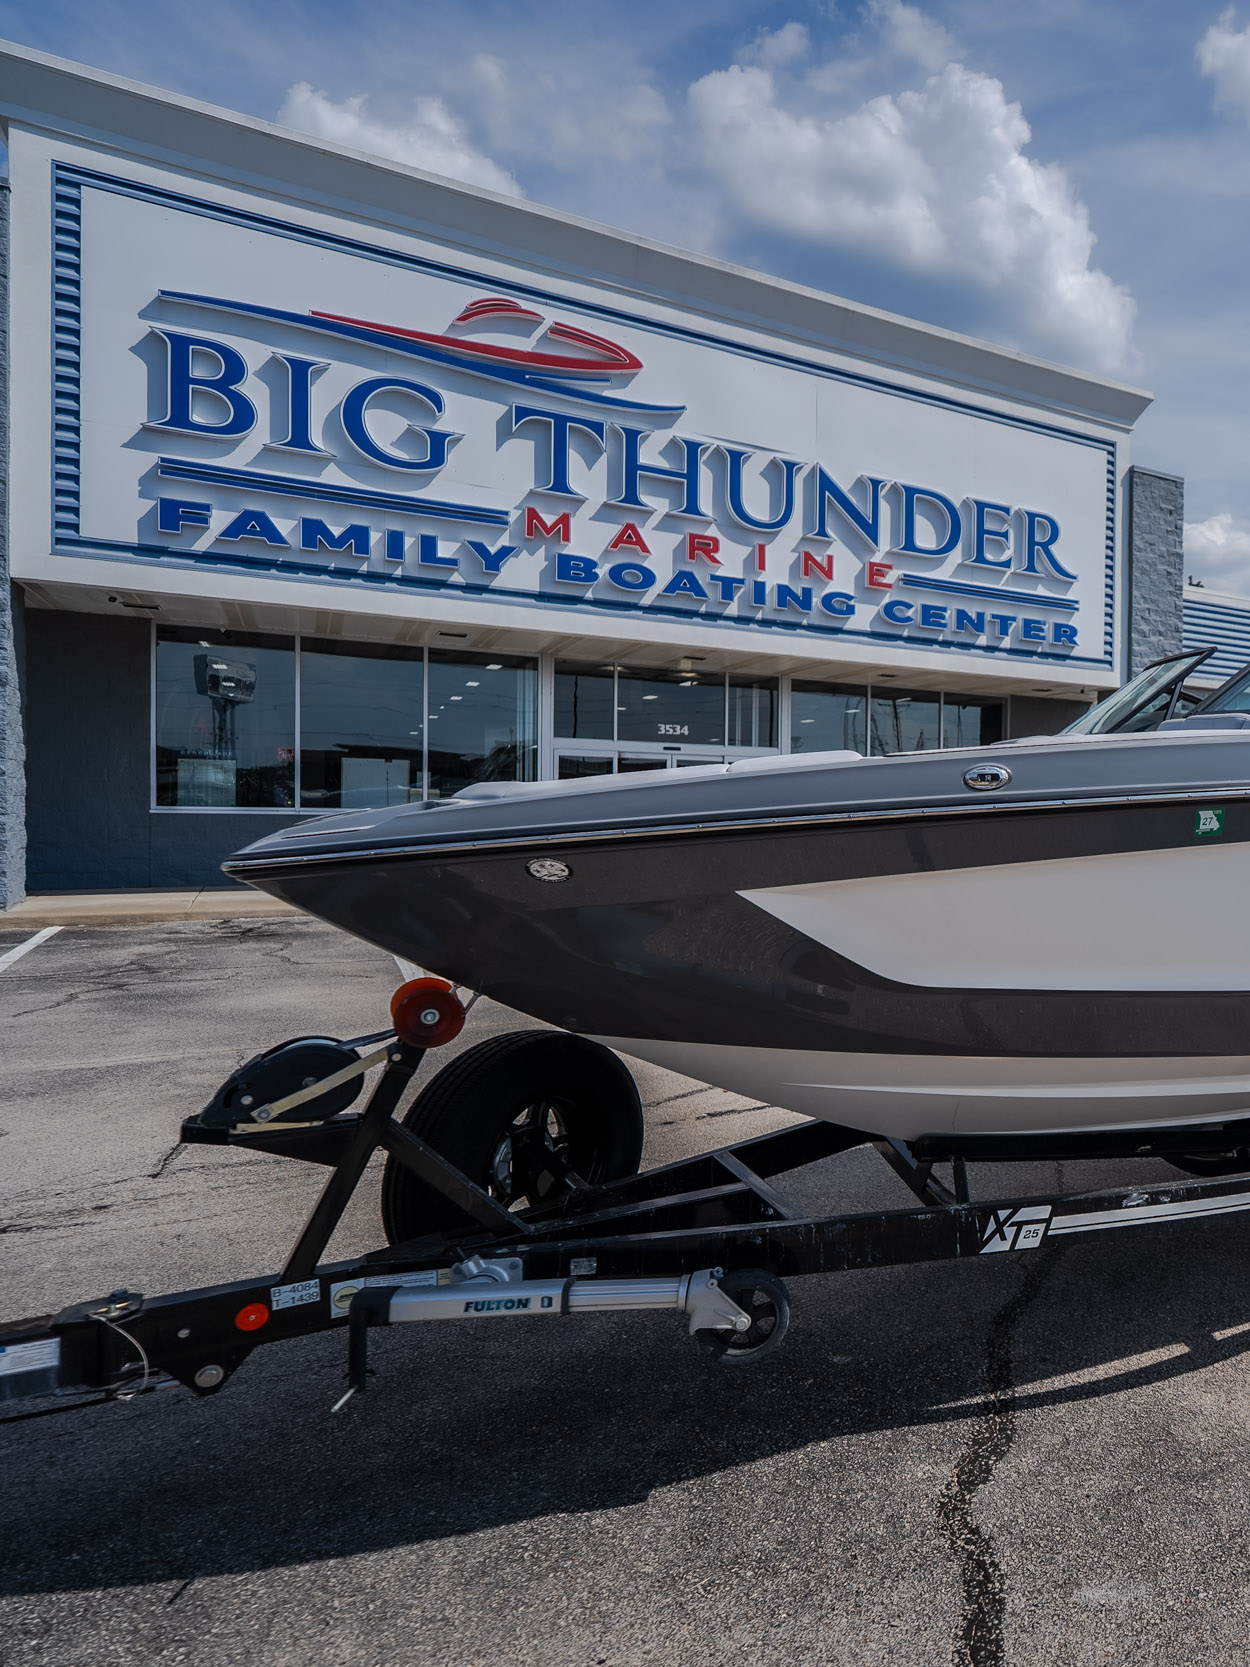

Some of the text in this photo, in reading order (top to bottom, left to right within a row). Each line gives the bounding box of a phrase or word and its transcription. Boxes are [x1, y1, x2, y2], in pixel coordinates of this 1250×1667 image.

[139, 325, 1079, 583] BIG THUNDER
[524, 505, 895, 589] MARINE
[156, 496, 1079, 648] FAMILY BOATING CENTER
[657, 723, 690, 736] 3534
[1201, 816, 1214, 826] 27
[1022, 1228, 1041, 1240] 25
[272, 1280, 320, 1298] B-4084
[273, 1291, 320, 1309] T-1439
[463, 1297, 532, 1313] FULTON
